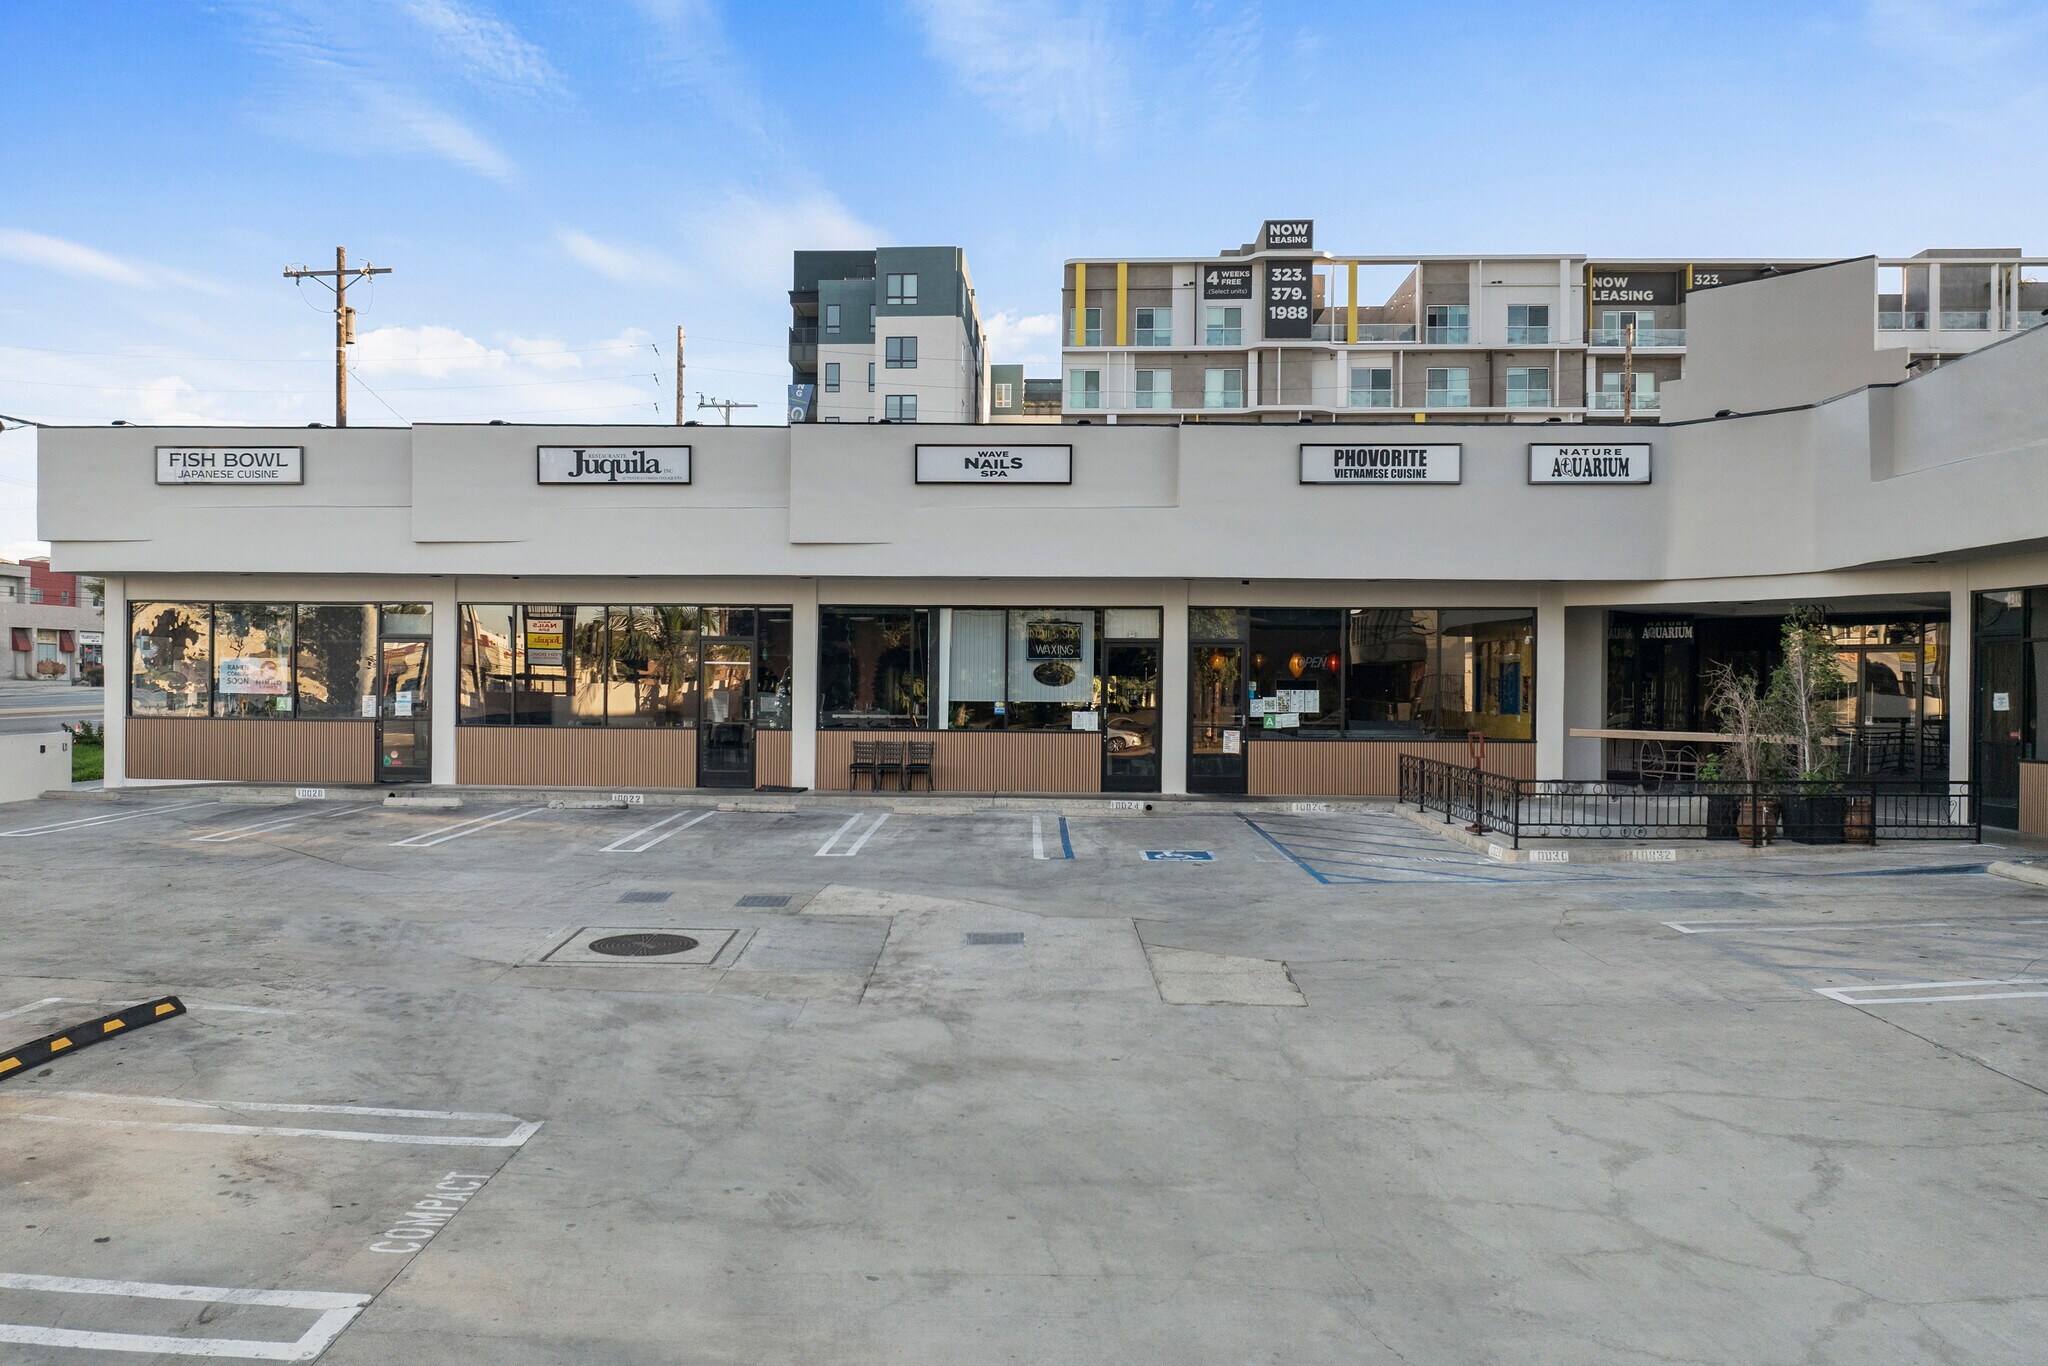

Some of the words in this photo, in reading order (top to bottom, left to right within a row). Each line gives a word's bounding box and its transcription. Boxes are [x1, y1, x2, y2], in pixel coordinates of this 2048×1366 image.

[1269, 224, 1308, 235] NOW
[1206, 271, 1219, 285] 4
[1272, 268, 1307, 281] 323.
[1694, 274, 1722, 285] 323.
[1592, 277, 1628, 288] NOW
[1271, 287, 1307, 300] 379.
[1592, 291, 1654, 301] LEASING
[1269, 306, 1308, 320] 1988
[169, 453, 215, 467] FISH
[224, 453, 288, 467] BOWL
[964, 457, 1023, 469] NAILS
[1333, 449, 1427, 467] PHOVORITE
[567, 450, 662, 481] Juquila
[1551, 457, 1630, 477] AQUARIUM
[178, 470, 234, 479] JAPANESE
[237, 470, 279, 479] CUISINE
[1334, 469, 1389, 479] VIETNAMESE
[1390, 469, 1427, 479] CUISINE
[1641, 626, 1693, 639] AQUARIUM
[1035, 645, 1074, 655] WAXING
[1298, 657, 1328, 668] OPEN
[279, 700, 286, 708] A
[1265, 717, 1274, 726] A
[369, 1171, 491, 1253] COMPACT
